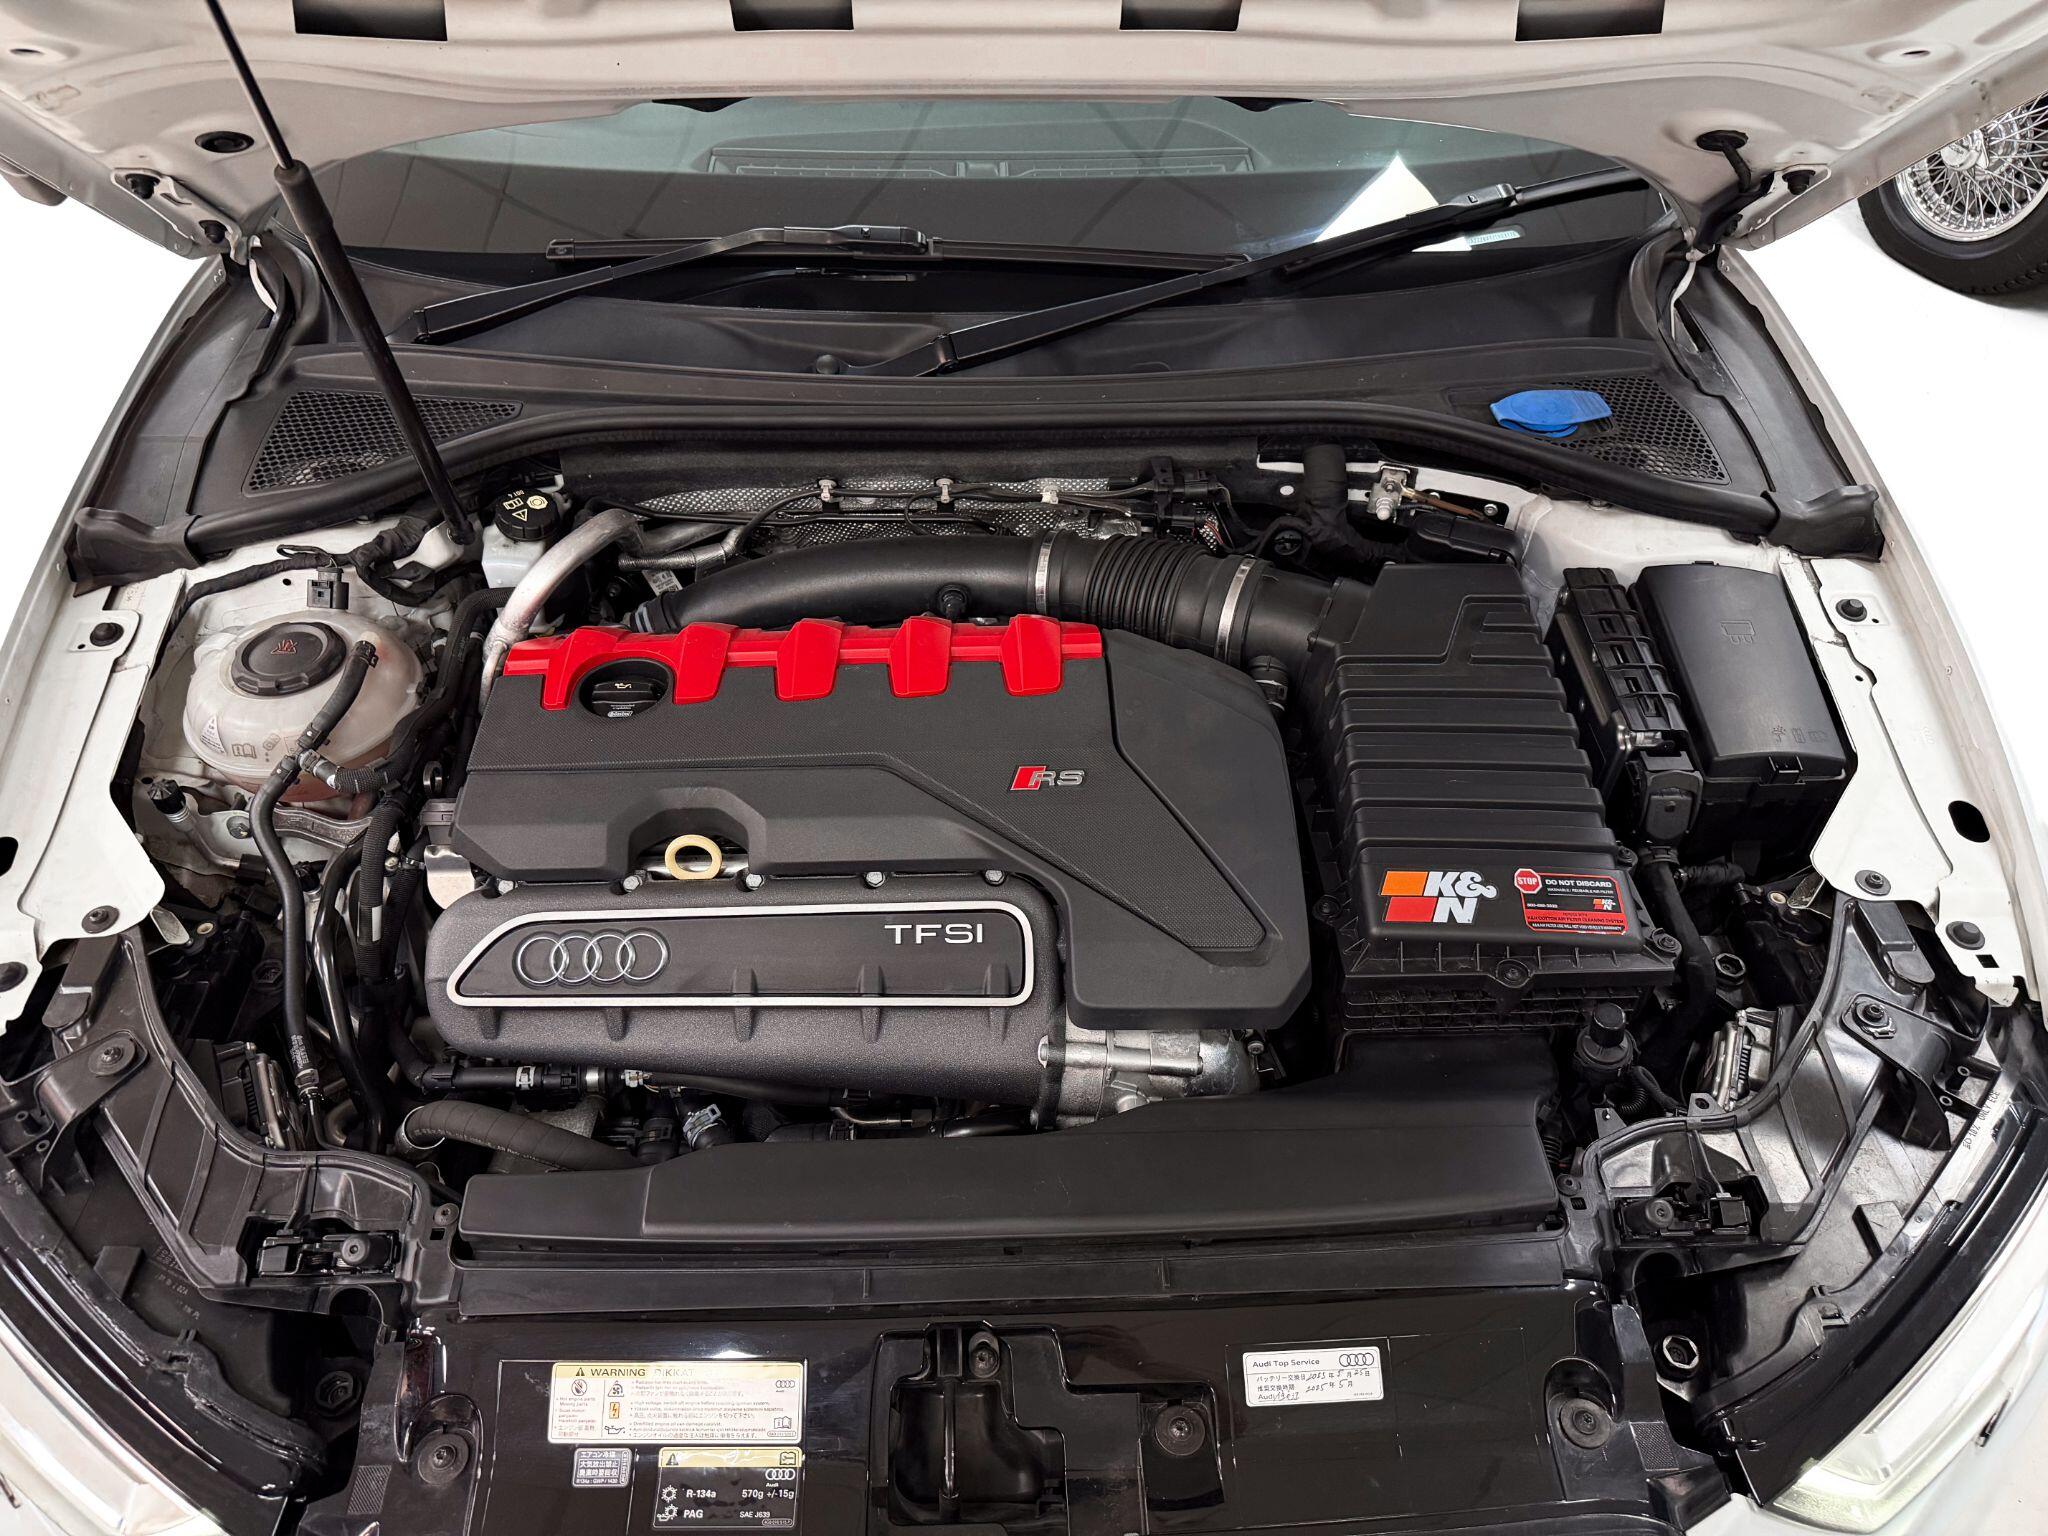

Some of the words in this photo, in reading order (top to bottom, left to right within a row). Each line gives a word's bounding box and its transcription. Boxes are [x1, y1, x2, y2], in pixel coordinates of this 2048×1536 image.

[1028, 770, 1084, 787] RS
[1518, 877, 1538, 886] STOP
[884, 924, 983, 944] TFSI
[590, 1368, 646, 1376] WARNING
[686, 1490, 717, 1498] R-134a
[742, 1489, 764, 1499] 570g
[683, 1510, 704, 1518] PAG
